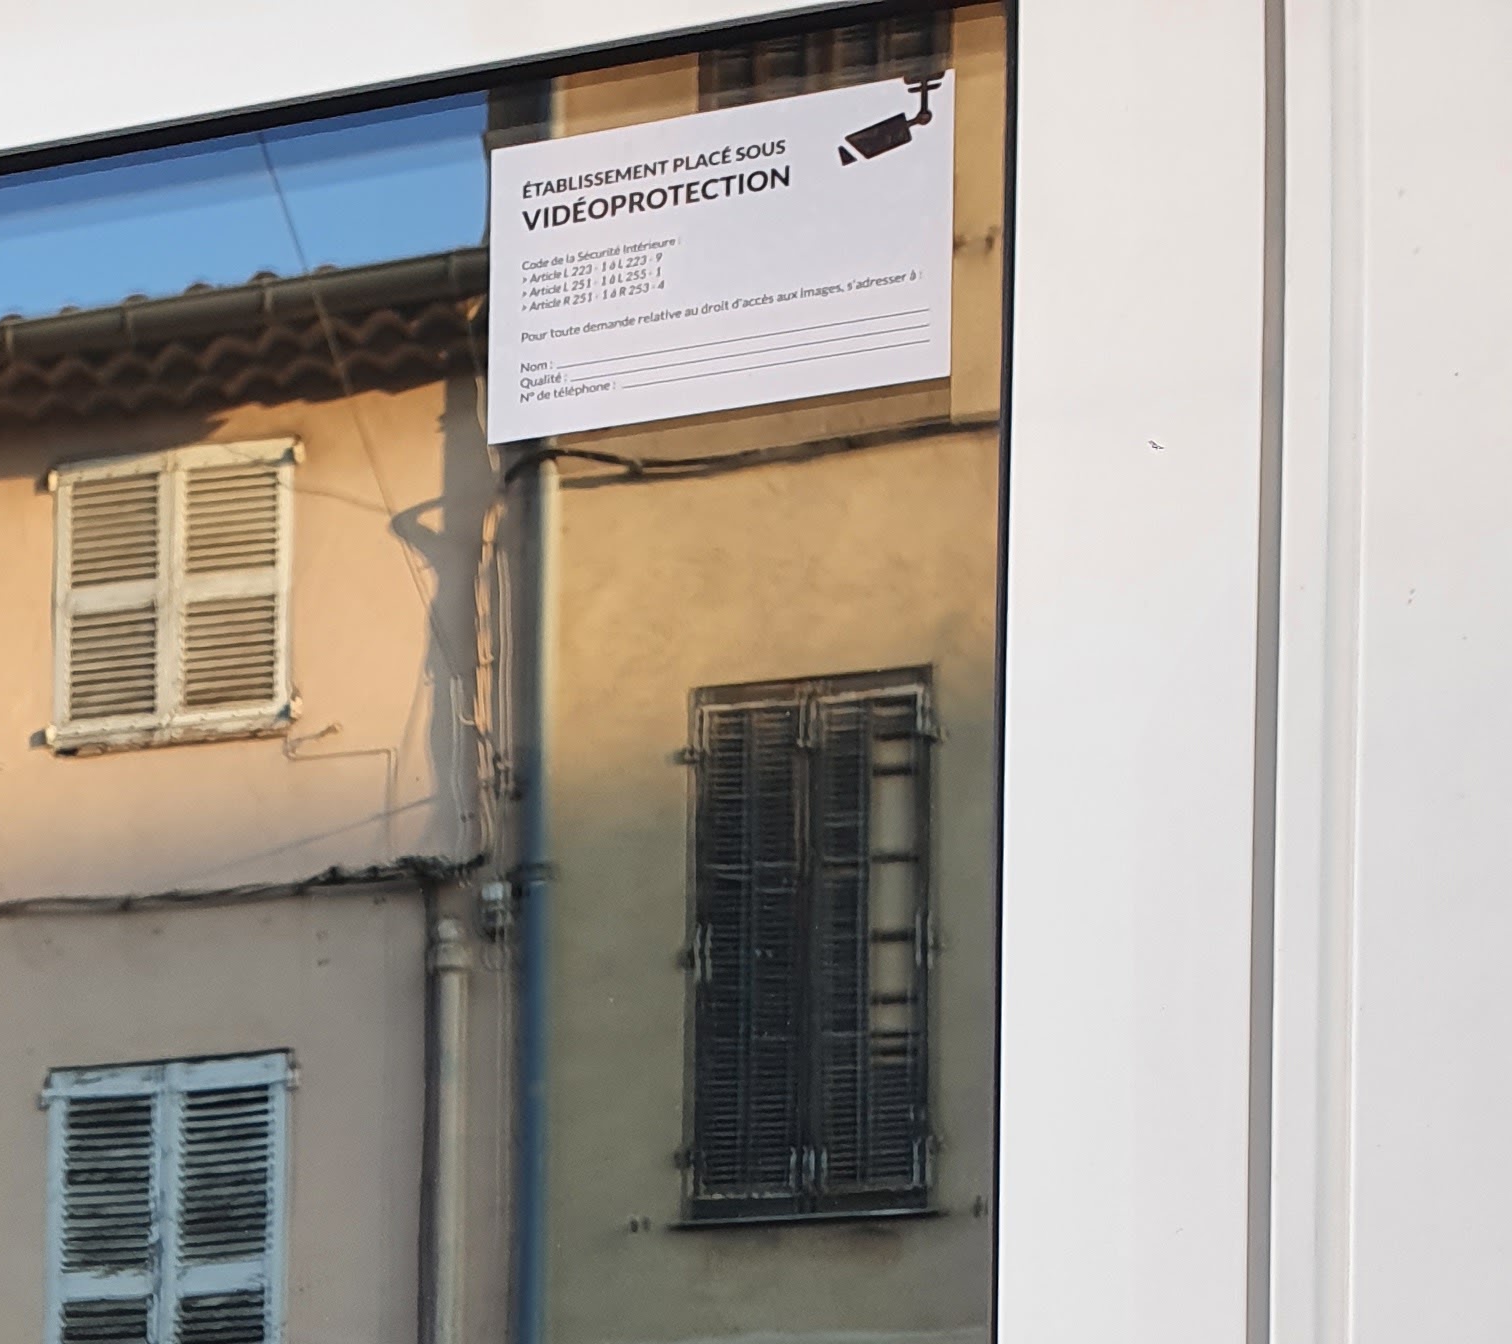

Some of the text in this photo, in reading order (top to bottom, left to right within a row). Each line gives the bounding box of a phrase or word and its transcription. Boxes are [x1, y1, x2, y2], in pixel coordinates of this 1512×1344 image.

[522, 139, 786, 199] ÉTABLISSEMENT PLACÉ SOUS
[522, 165, 790, 231] VIDÉOPROTECTION
[522, 257, 549, 270] Code
[551, 255, 564, 266] de
[566, 253, 575, 263] la
[577, 247, 621, 262] Sécurité
[623, 238, 676, 254] Intérieure
[529, 270, 562, 284] Article
[529, 284, 561, 298] Article
[521, 330, 547, 343] Pour
[550, 324, 581, 339] toute
[583, 316, 636, 334] demande
[637, 308, 682, 325] relative
[685, 307, 699, 318] au
[701, 298, 729, 315] droit
[731, 293, 774, 310] d'accès
[777, 290, 798, 302] aux
[847, 272, 906, 291] s'adresser
[529, 298, 562, 312] Article
[520, 361, 548, 373] Nom
[520, 374, 562, 389] Qualité
[537, 389, 550, 401] de
[554, 380, 611, 398] téléphone
